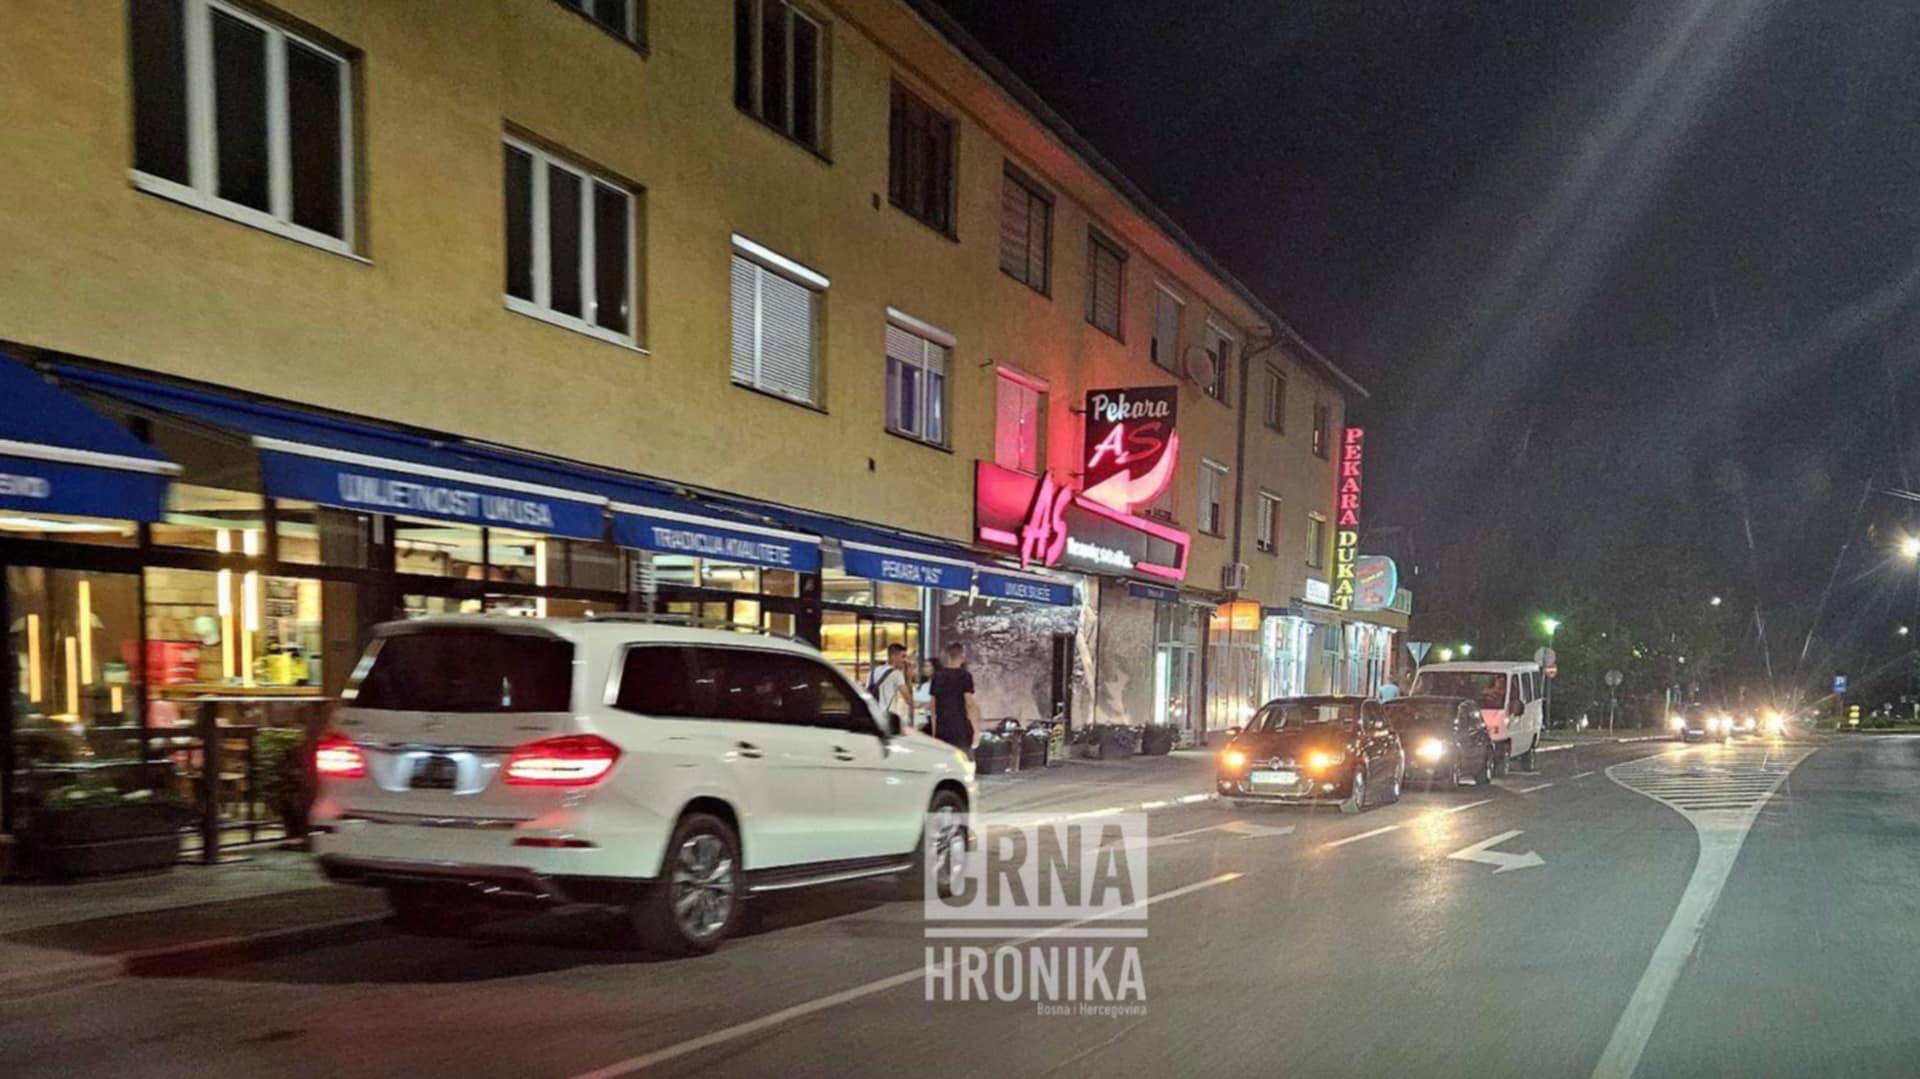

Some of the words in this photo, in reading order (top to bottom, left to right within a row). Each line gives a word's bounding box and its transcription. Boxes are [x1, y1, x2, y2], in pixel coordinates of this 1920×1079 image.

[1089, 423, 1163, 467] AS
[1092, 393, 1170, 423] Pekara
[1340, 428, 1363, 525] PEKARA
[1021, 472, 1072, 568] AS
[1335, 531, 1358, 610] DUKAT
